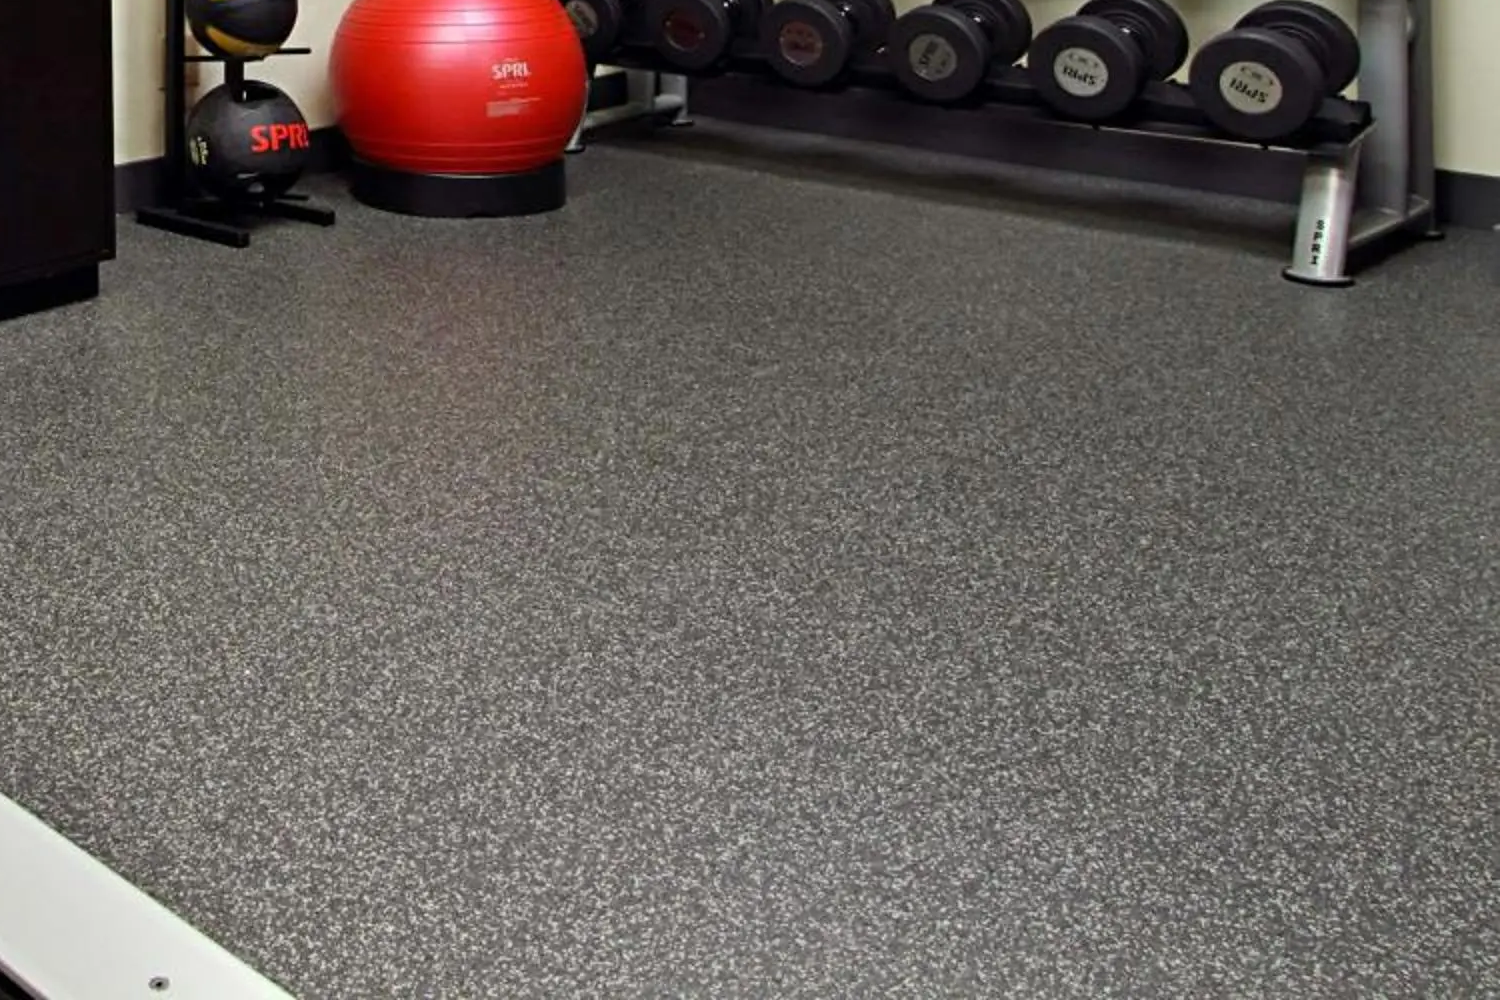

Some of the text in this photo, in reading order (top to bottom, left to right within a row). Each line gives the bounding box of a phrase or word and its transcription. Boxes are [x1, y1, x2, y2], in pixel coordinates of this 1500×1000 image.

[492, 62, 529, 80] SPRI
[1062, 63, 1097, 87] SPRI
[1228, 77, 1270, 104] SPRI
[250, 121, 309, 153] SPRI
[1310, 219, 1325, 265] SPRI
